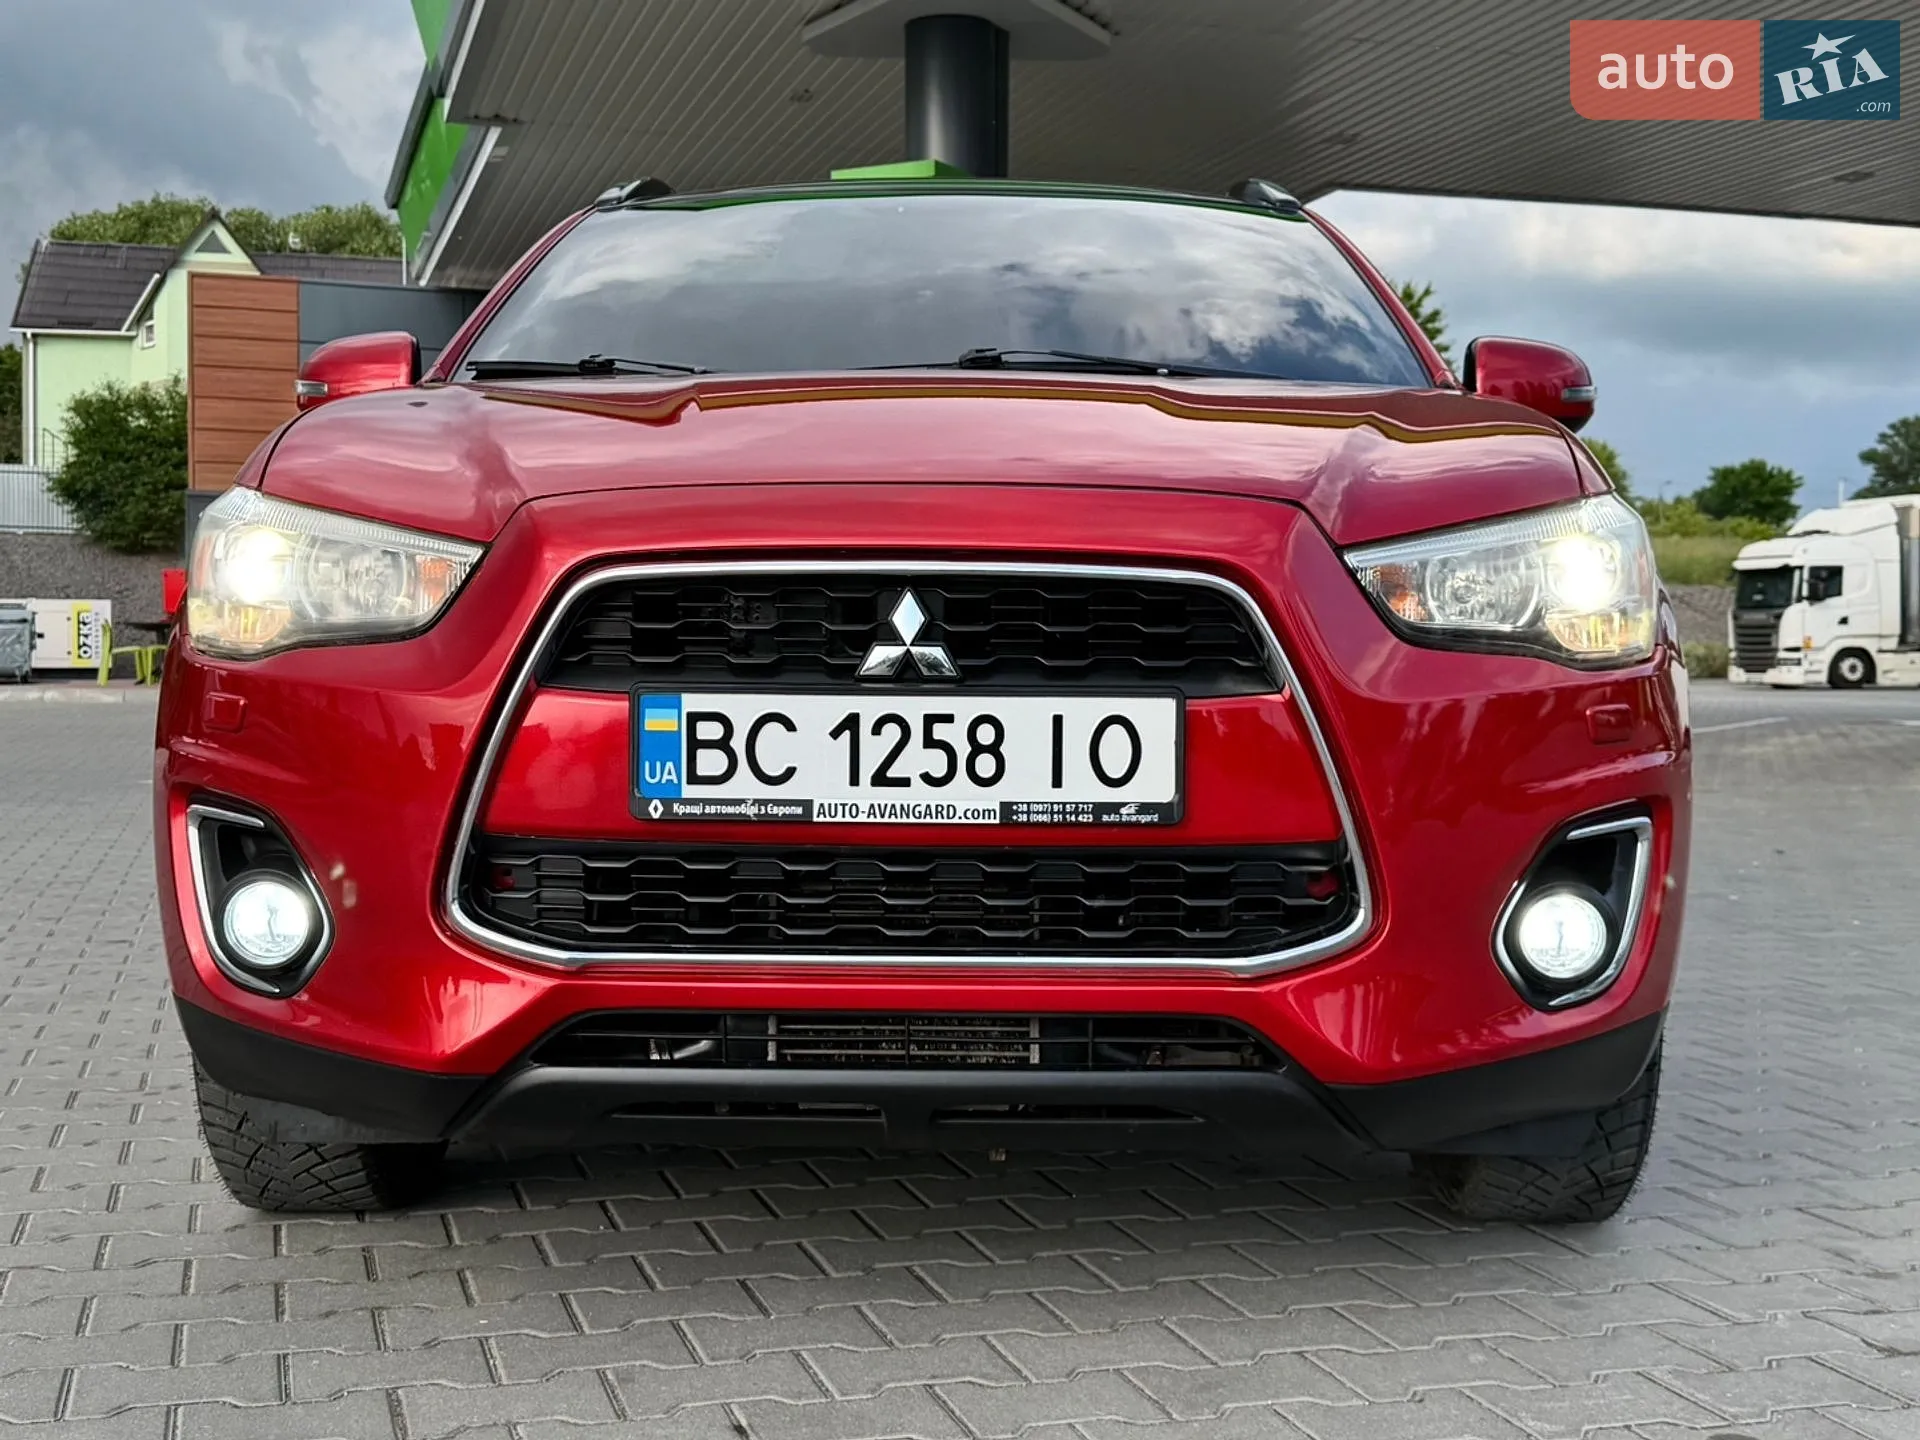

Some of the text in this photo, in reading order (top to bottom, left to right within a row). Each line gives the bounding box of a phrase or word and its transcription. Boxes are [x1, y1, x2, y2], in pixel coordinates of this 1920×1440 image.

[686, 711, 798, 787] BC
[828, 712, 1006, 789] 1258
[644, 760, 678, 784] UA
[673, 802, 702, 816] Кращі
[760, 805, 766, 814] з
[767, 803, 802, 816] Європи
[816, 803, 997, 820] AUTO-AVANGARD.com
[1012, 803, 1028, 812] +38
[1029, 803, 1051, 813] (097)
[1078, 804, 1094, 812] 717
[1012, 813, 1028, 822] +38
[1065, 814, 1076, 822] 14
[1101, 814, 1119, 822] auto
